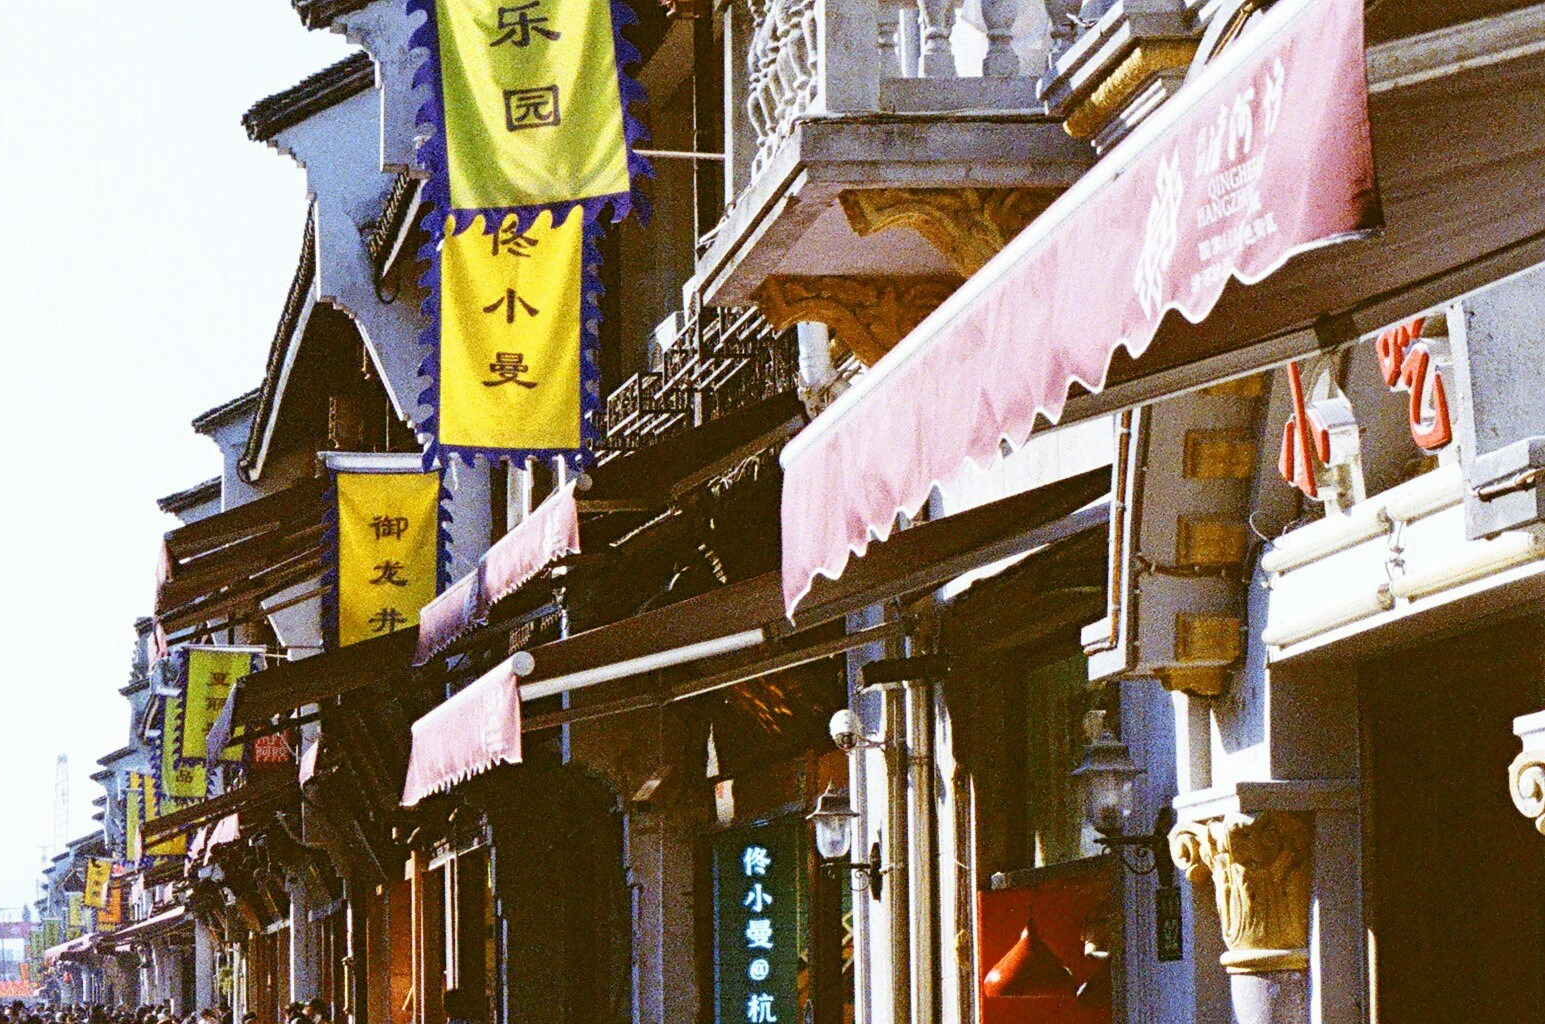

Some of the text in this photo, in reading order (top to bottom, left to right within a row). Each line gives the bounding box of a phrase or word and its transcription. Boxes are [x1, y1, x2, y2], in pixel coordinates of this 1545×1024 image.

[490, 0, 562, 132] 乐园
[482, 220, 540, 389] 佟小曼
